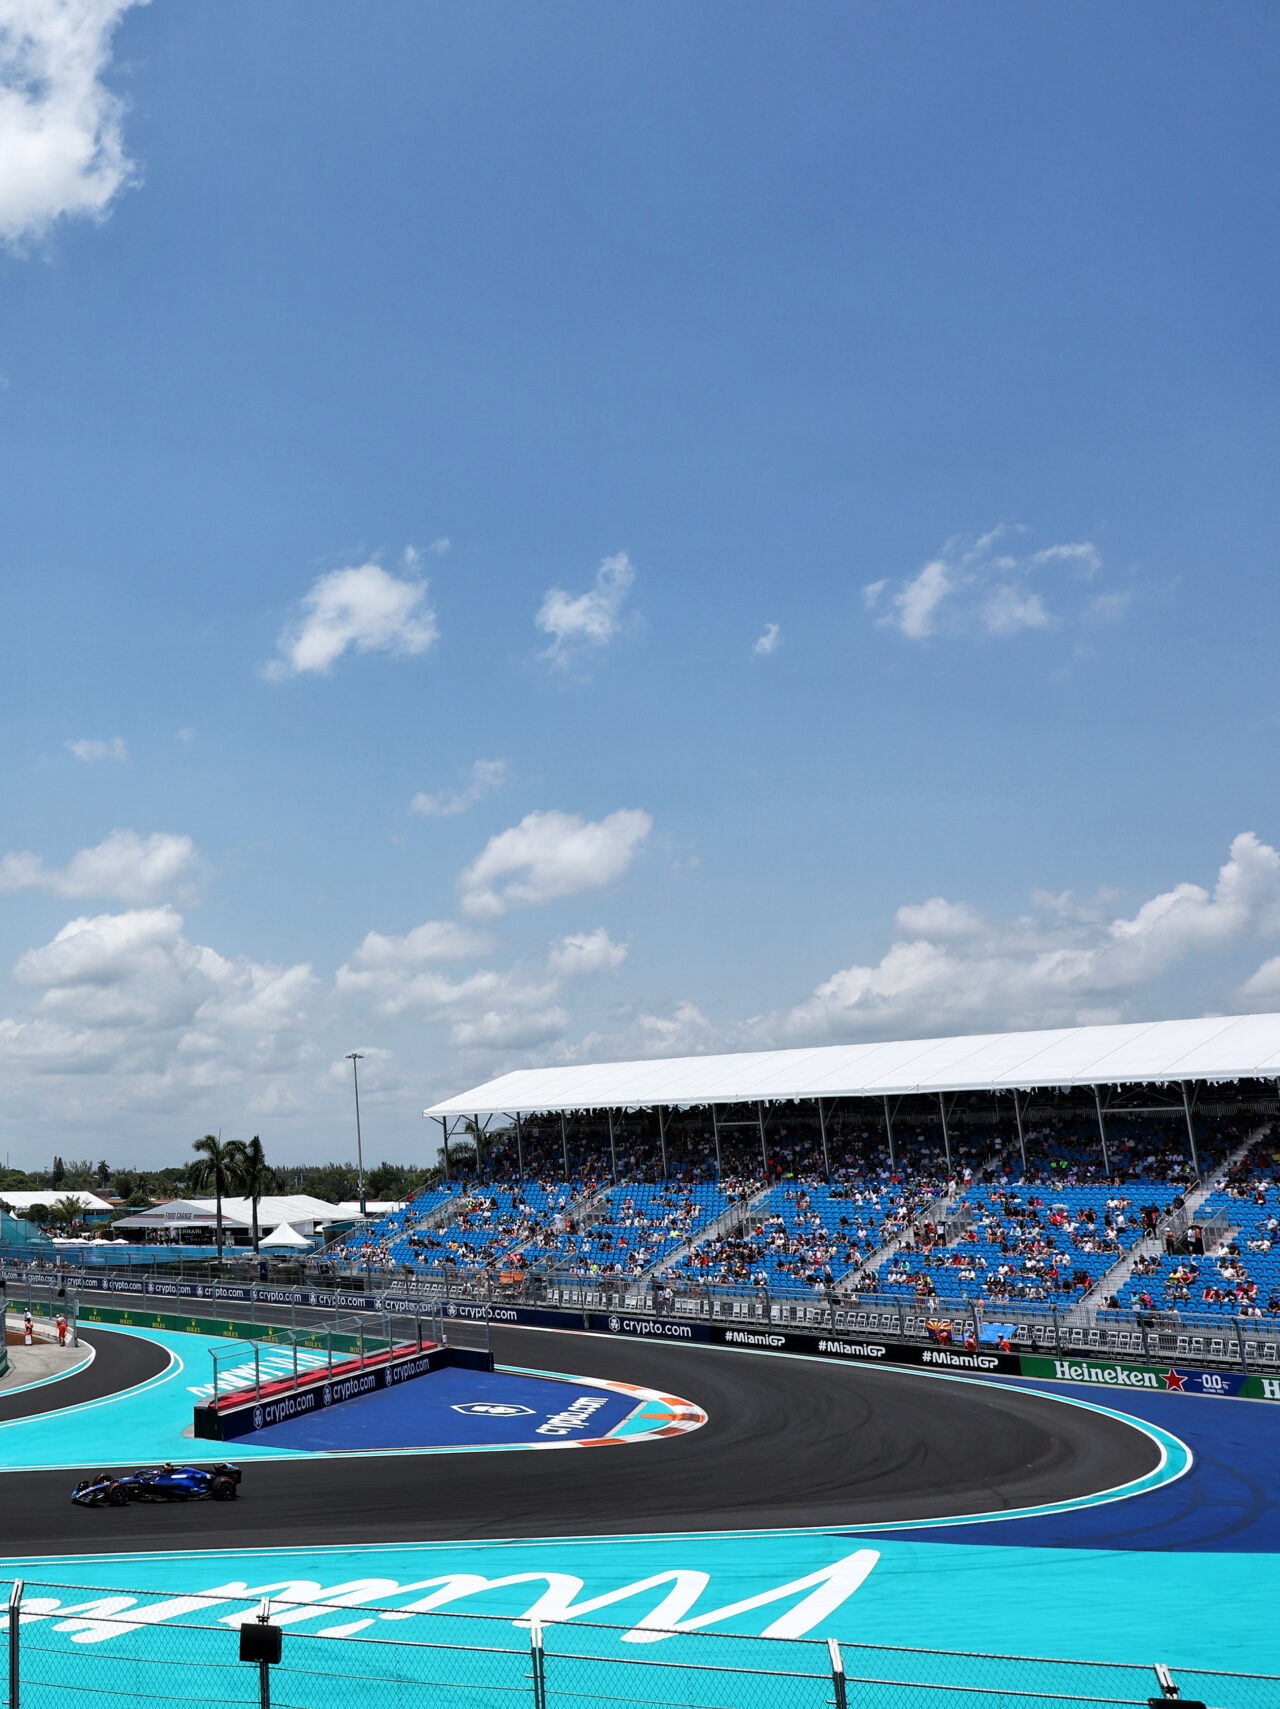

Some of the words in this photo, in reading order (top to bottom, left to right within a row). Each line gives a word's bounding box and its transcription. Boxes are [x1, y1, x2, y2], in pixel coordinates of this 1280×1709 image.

[223, 1330, 239, 1338] ROLEX
[624, 1318, 692, 1338] crypto.com
[304, 1340, 322, 1349] ROLEX
[725, 1330, 786, 1347] #MiamiGP
[818, 1339, 886, 1358] #MiamiGP
[393, 1357, 430, 1381] crypto.com
[922, 1350, 999, 1369] #MiamiGP
[1054, 1360, 1159, 1388] Heineken
[333, 1374, 376, 1400] crypto.com
[265, 1391, 315, 1422] crypto.com
[535, 1396, 609, 1436] crypto.com
